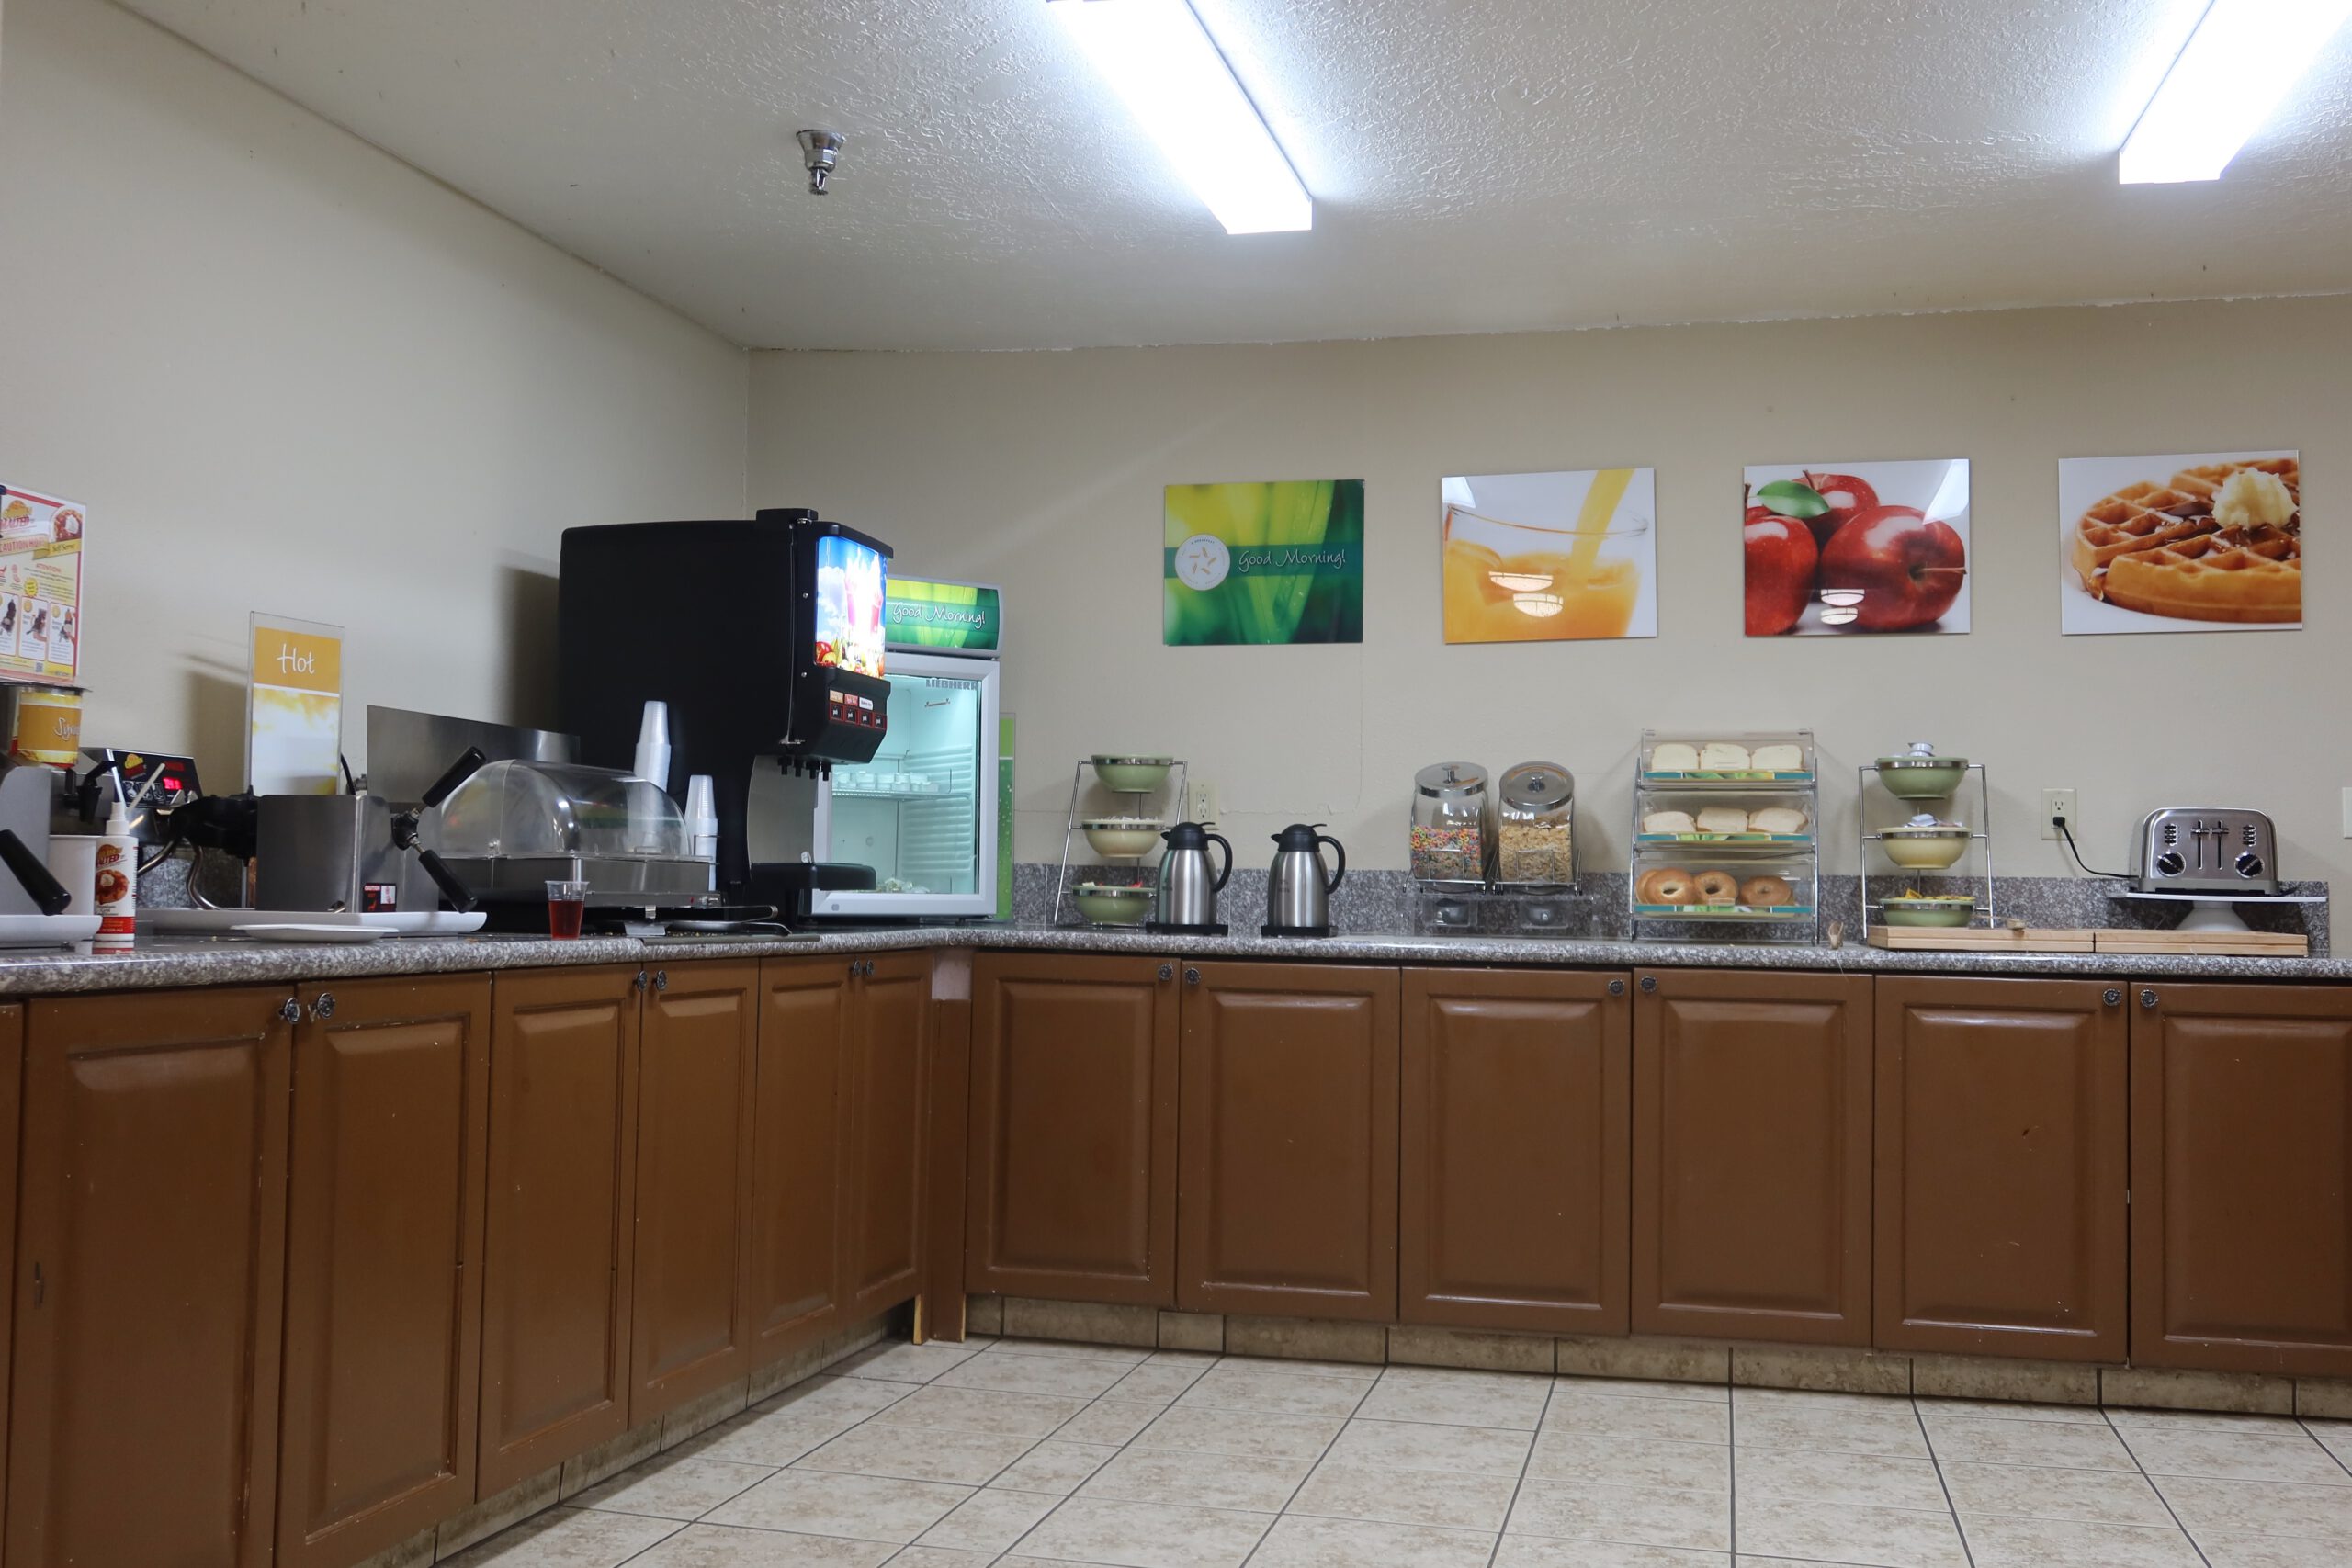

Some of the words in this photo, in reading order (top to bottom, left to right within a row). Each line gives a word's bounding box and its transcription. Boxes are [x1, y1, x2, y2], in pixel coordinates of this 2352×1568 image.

[1238, 550, 1272, 572] Good
[1275, 548, 1346, 570] Morning!
[892, 602, 922, 624] Good
[924, 604, 986, 630] Morning!
[277, 643, 315, 674] Hot
[925, 679, 978, 691] LIEBHERR
